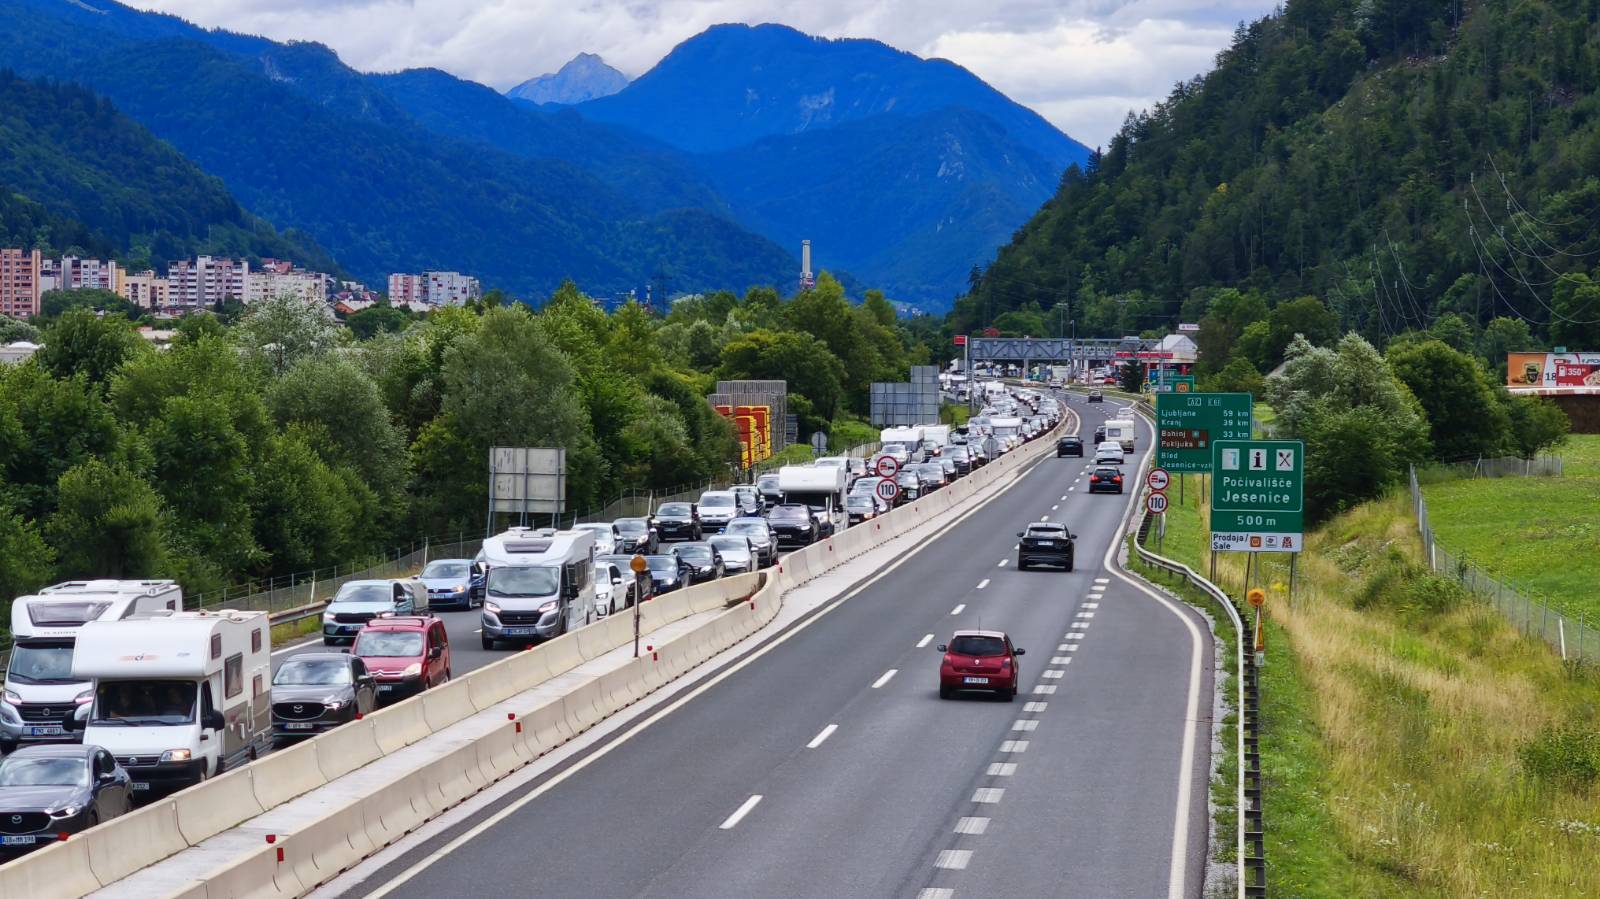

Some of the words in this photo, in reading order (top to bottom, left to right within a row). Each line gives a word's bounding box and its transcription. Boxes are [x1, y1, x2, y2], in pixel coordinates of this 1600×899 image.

[1161, 410, 1196, 418] Ljubljana
[1223, 476, 1292, 488] Počivališče
[881, 484, 895, 496] 110
[1222, 490, 1290, 503] Jesenice
[1150, 497, 1164, 509] 110
[1237, 515, 1262, 526] 500
